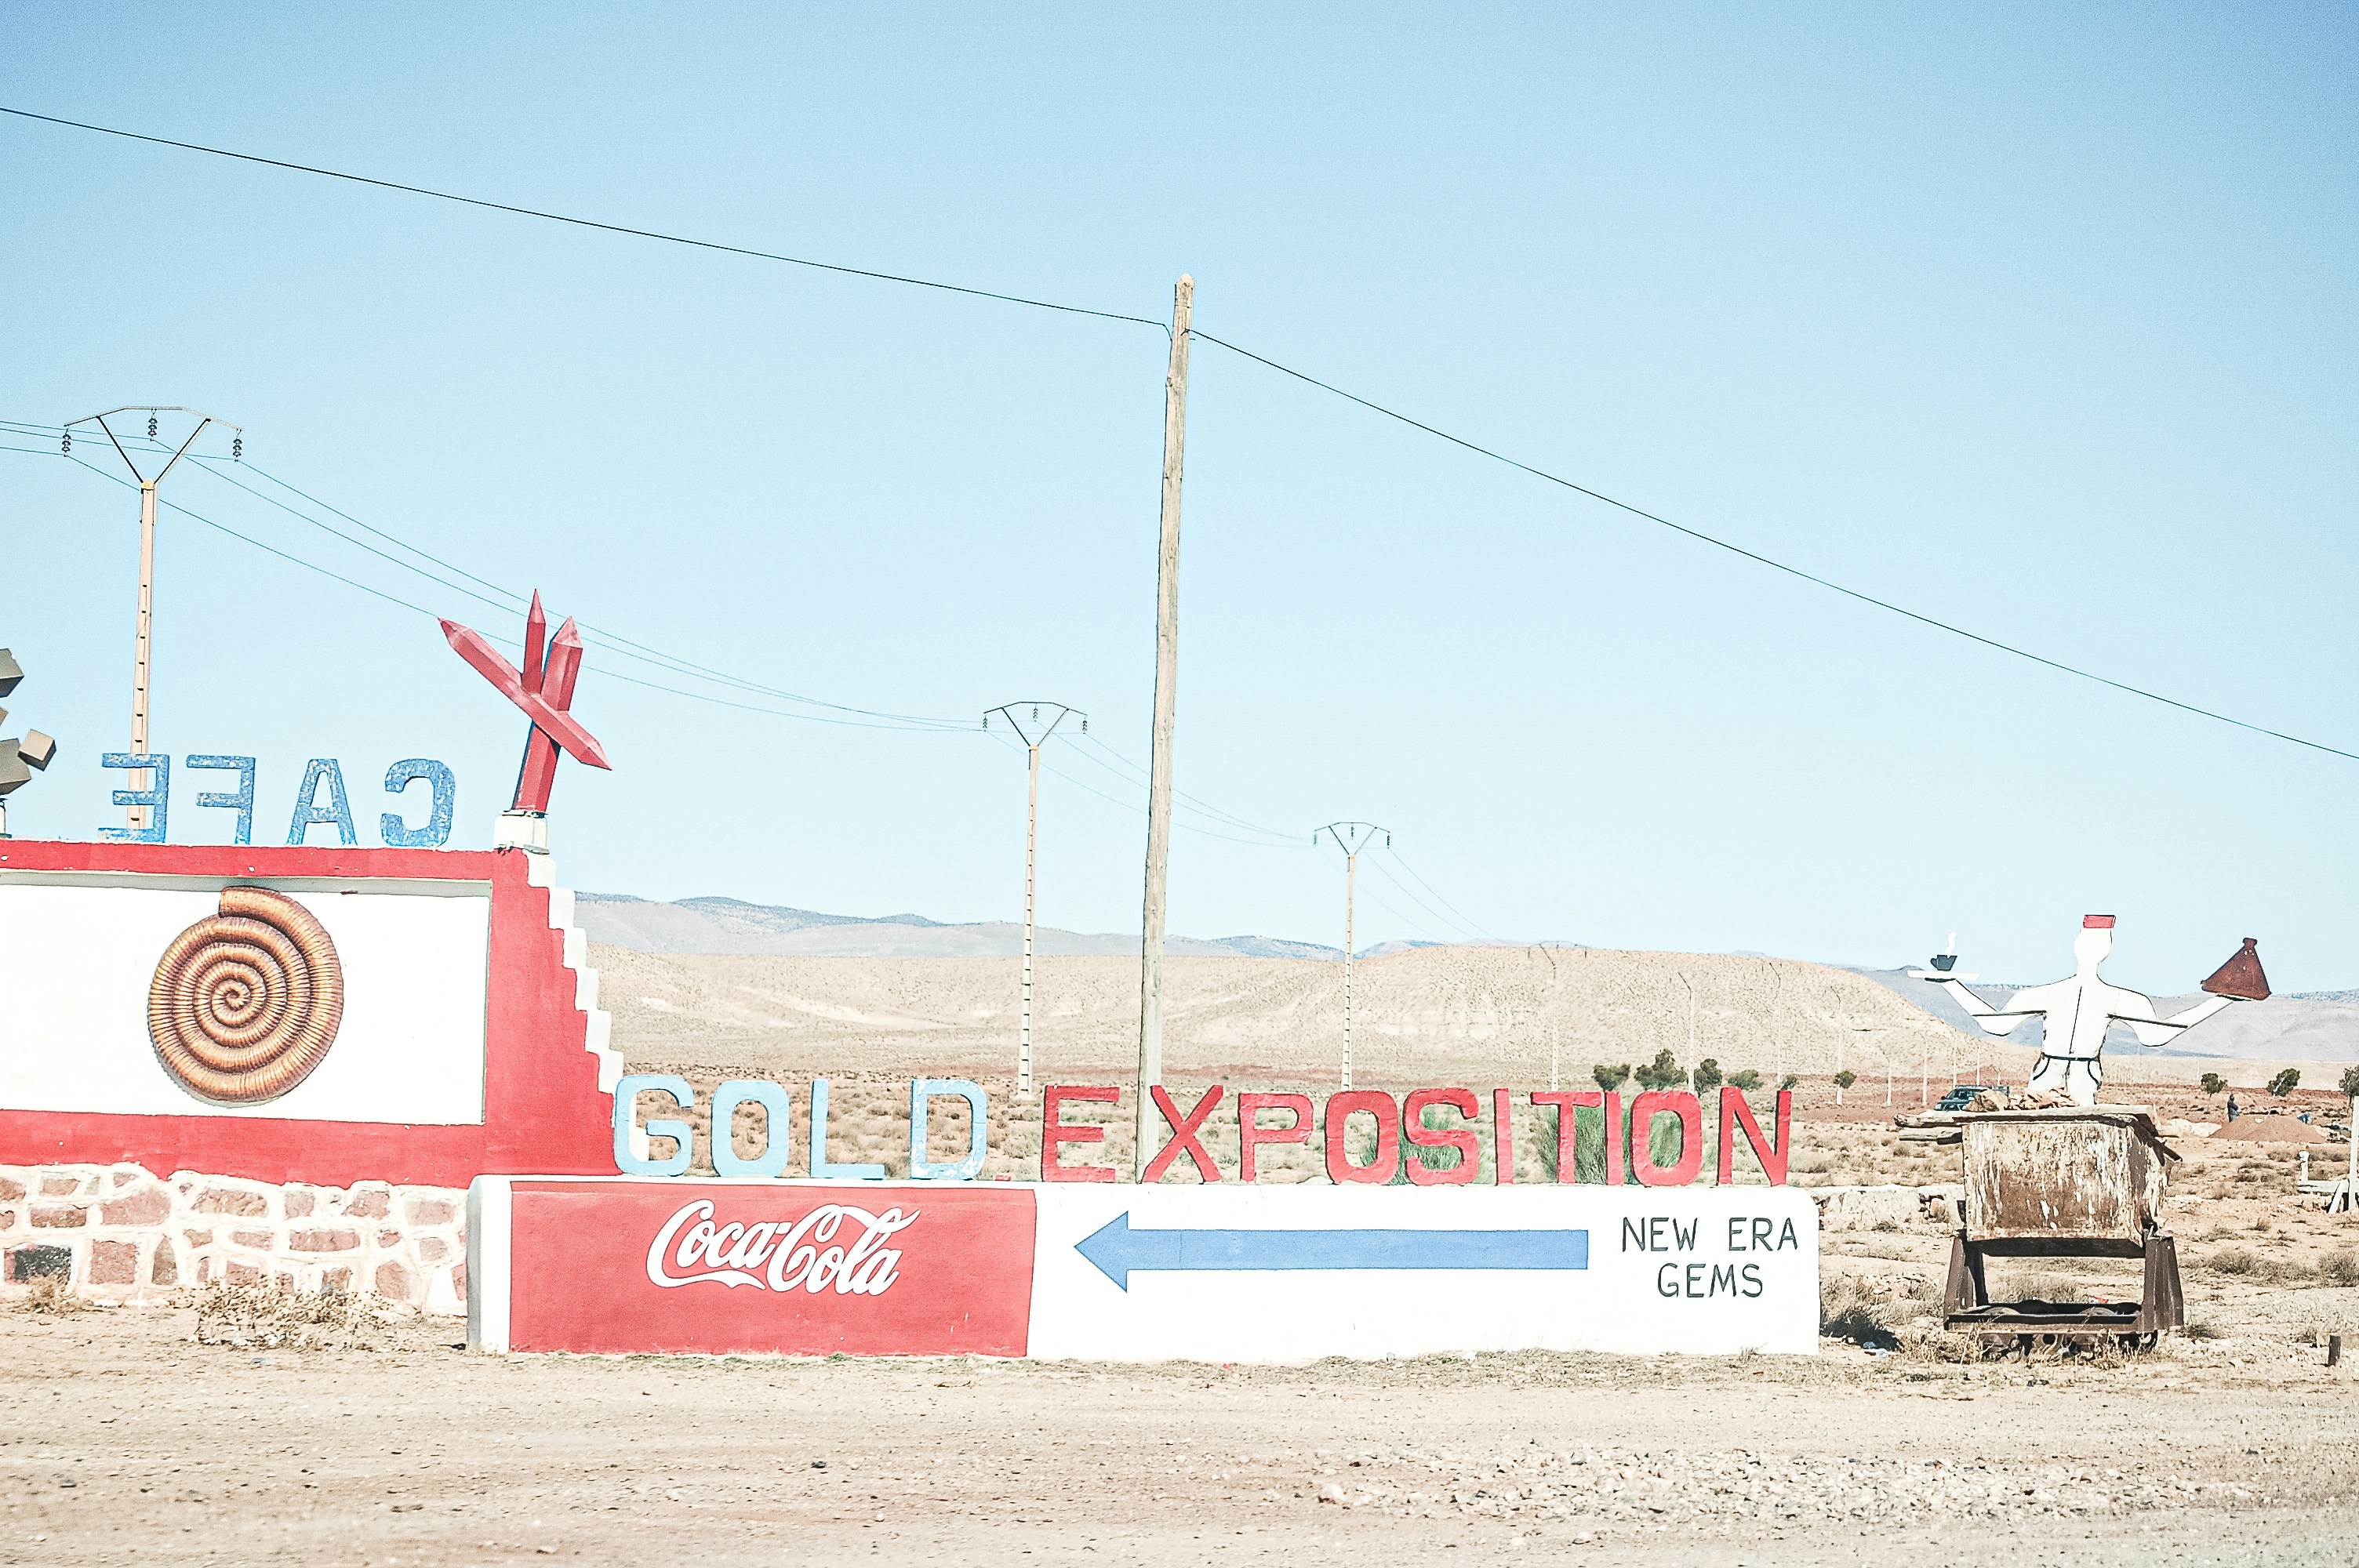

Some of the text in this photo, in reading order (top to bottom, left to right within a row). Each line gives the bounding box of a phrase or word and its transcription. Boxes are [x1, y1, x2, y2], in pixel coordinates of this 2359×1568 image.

[613, 1074, 1793, 1187] GOLD EXPOSITION
[646, 1198, 921, 1296] Coca-Cola
[1622, 1216, 1798, 1253] NEW ERA
[1656, 1263, 1764, 1298] GEMS
